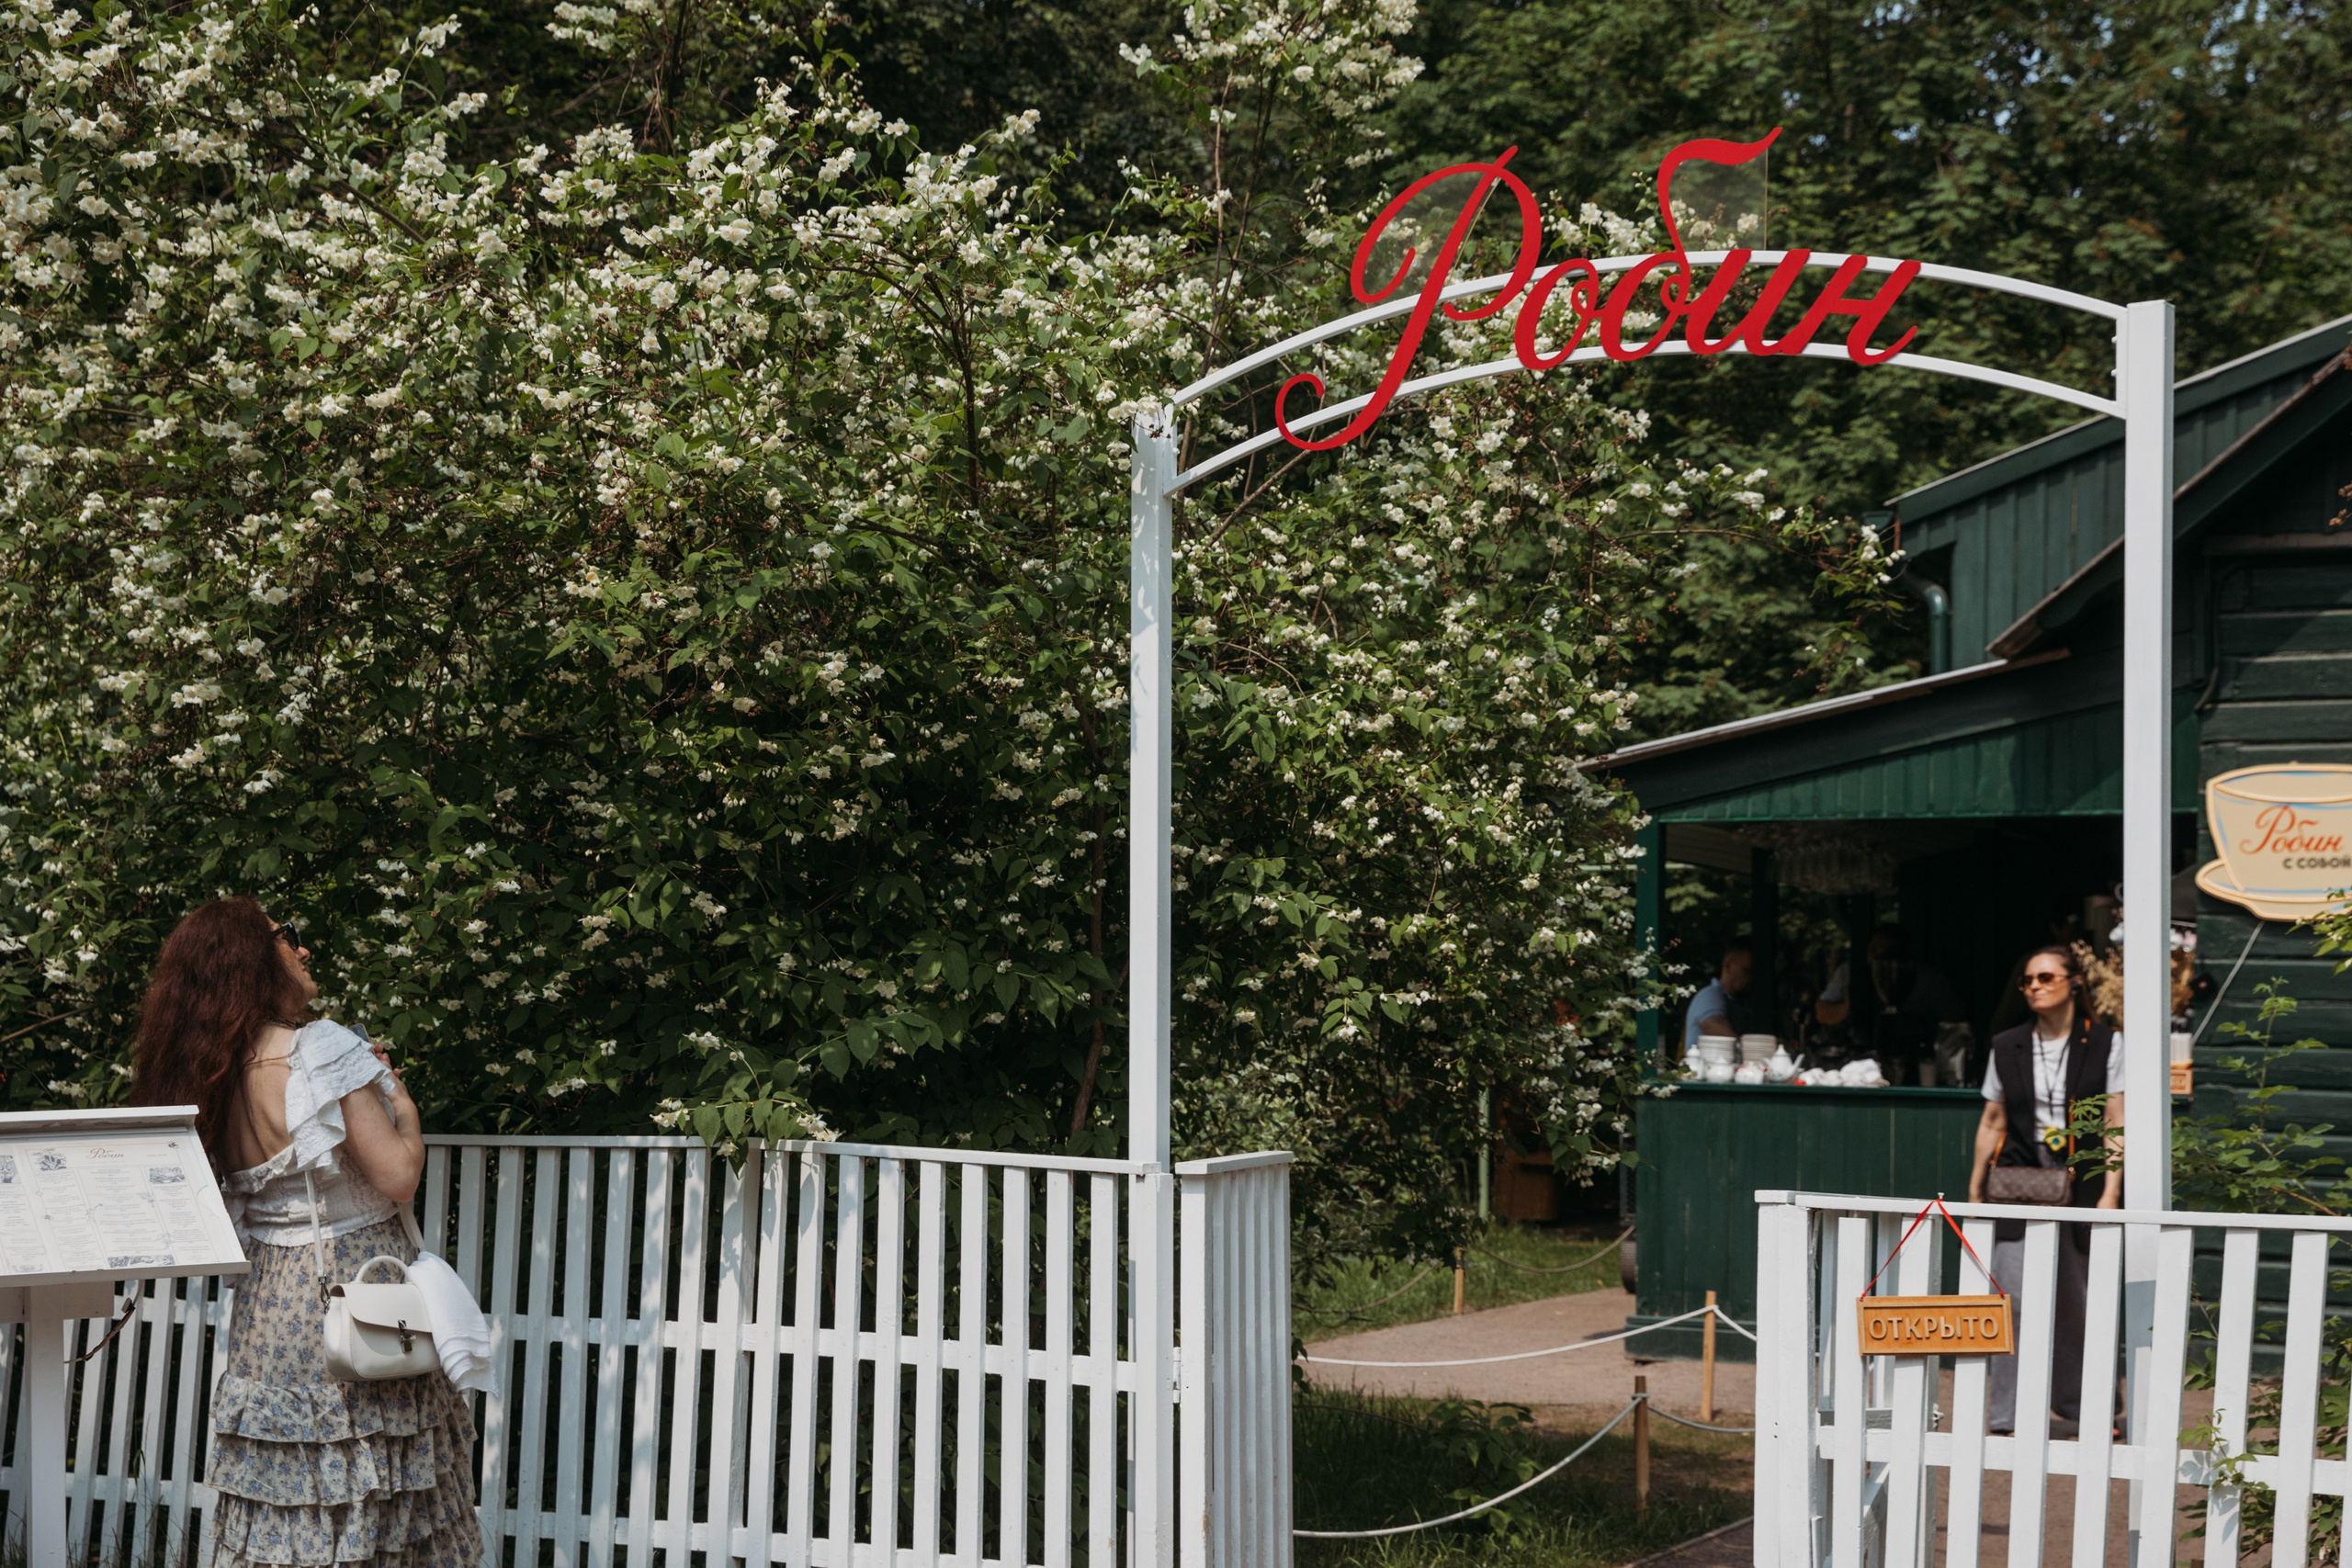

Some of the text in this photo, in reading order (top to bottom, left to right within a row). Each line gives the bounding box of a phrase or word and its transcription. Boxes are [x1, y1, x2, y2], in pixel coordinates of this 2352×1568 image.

[1275, 127, 1921, 450] Робин
[2239, 805, 2344, 854] Робин
[86, 1147, 125, 1159] Робин
[1869, 1316, 1999, 1339] ОТКРЫТО
